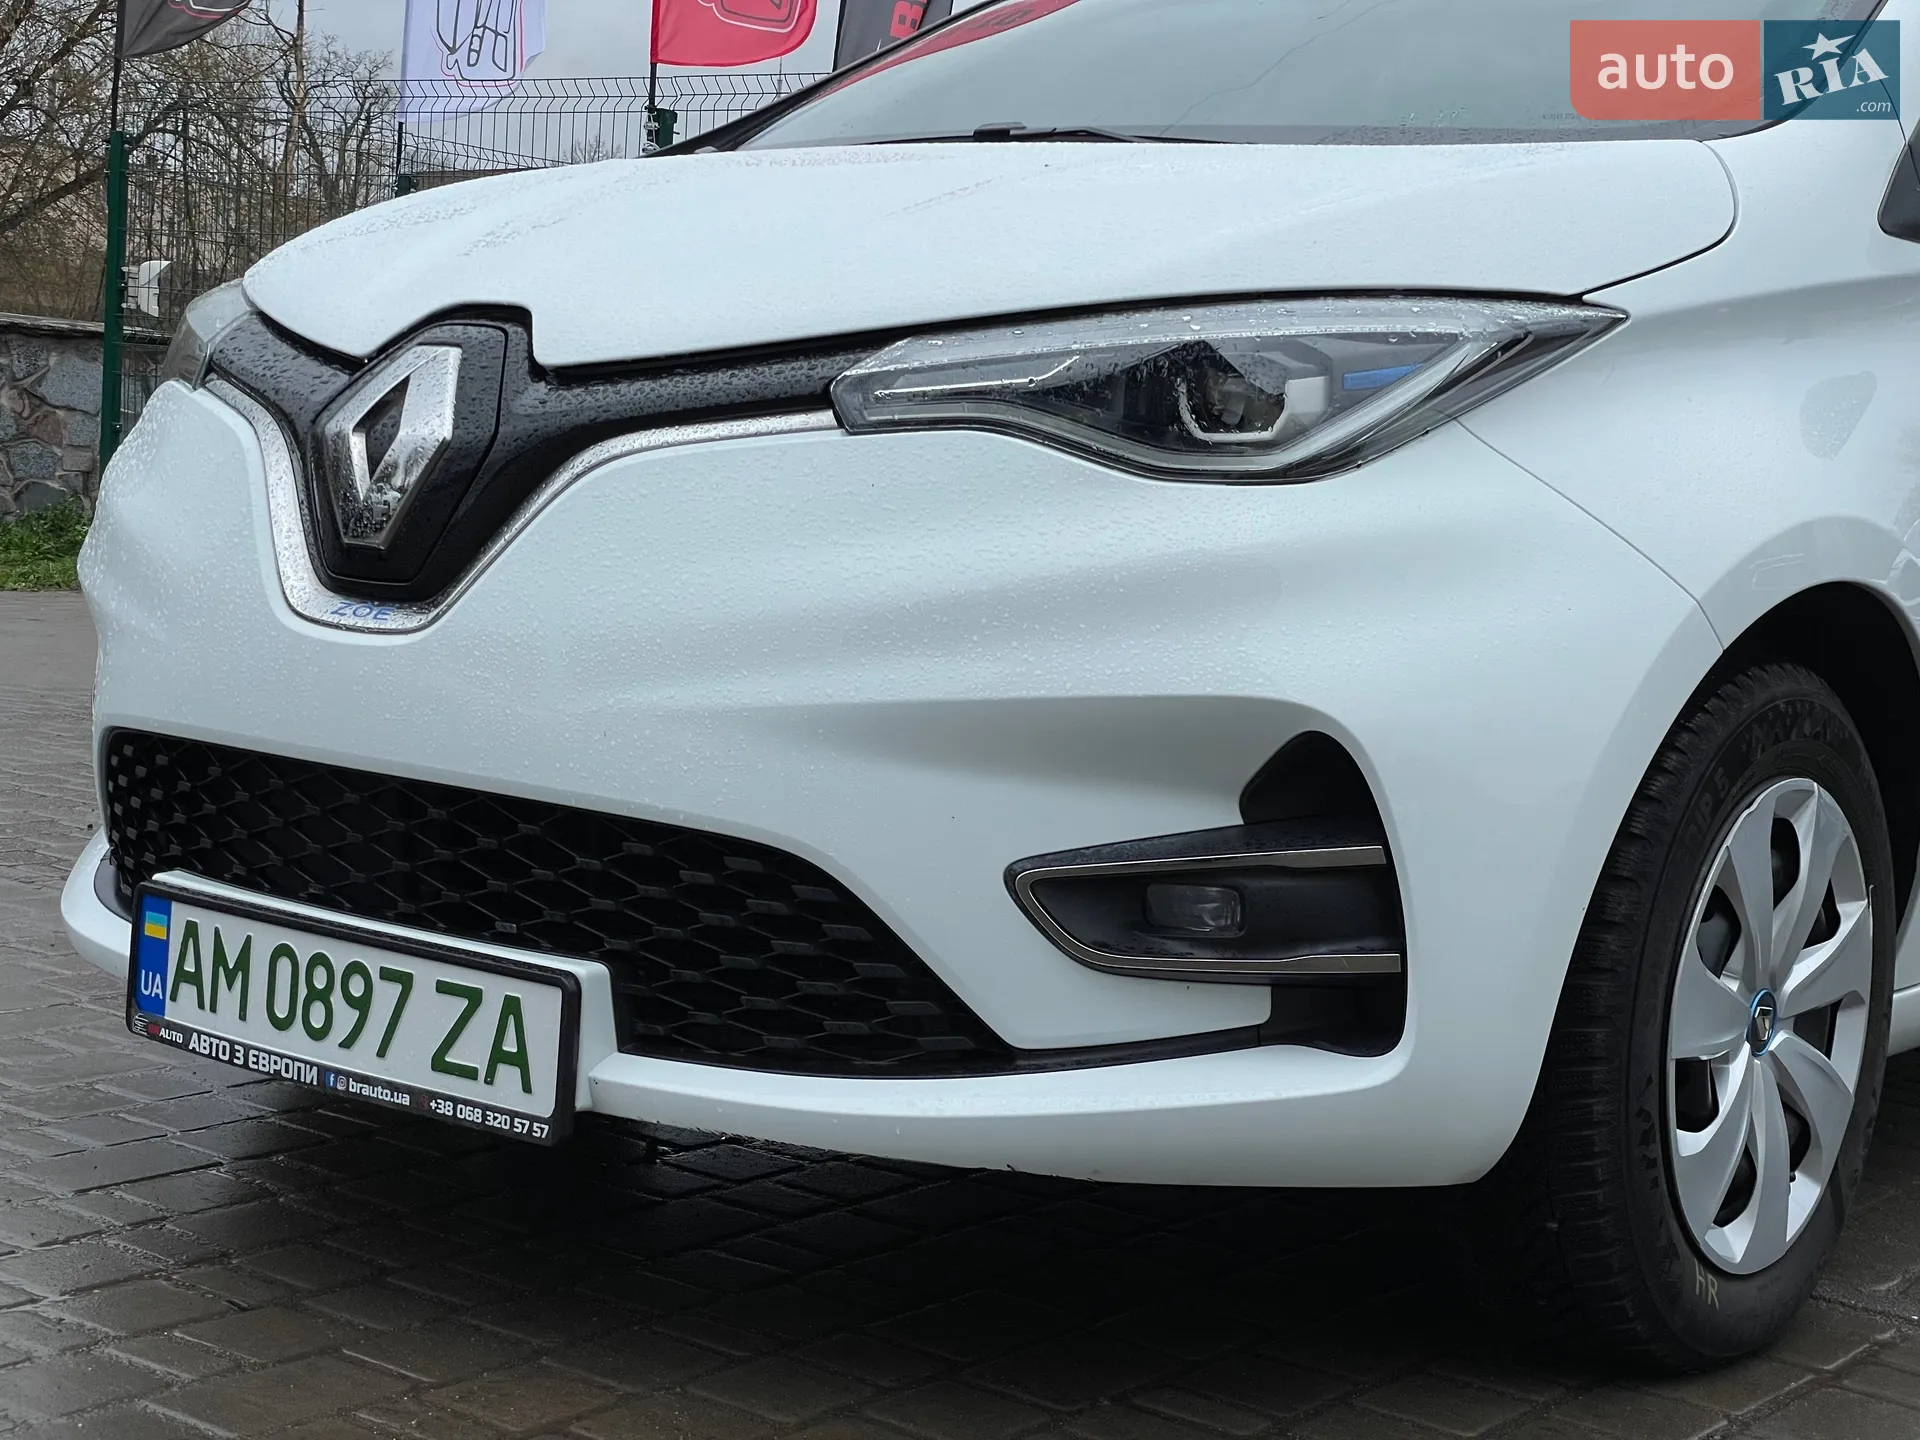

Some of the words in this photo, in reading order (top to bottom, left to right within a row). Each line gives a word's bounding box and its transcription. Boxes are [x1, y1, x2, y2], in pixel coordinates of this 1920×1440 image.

[330, 601, 396, 621] ZOE
[140, 969, 164, 1001] UA
[169, 919, 253, 1022] AM
[266, 942, 414, 1059] 0897
[430, 979, 533, 1095] ZA
[188, 1032, 230, 1061] АВТО
[233, 1044, 245, 1066] З
[248, 1050, 318, 1086] ЄВРОПИ
[349, 1078, 410, 1107] brauto.ua
[429, 1098, 454, 1117] +38
[456, 1105, 483, 1124] 068
[485, 1110, 511, 1130] 320
[513, 1117, 530, 1135] 57
[532, 1122, 549, 1140] 57
